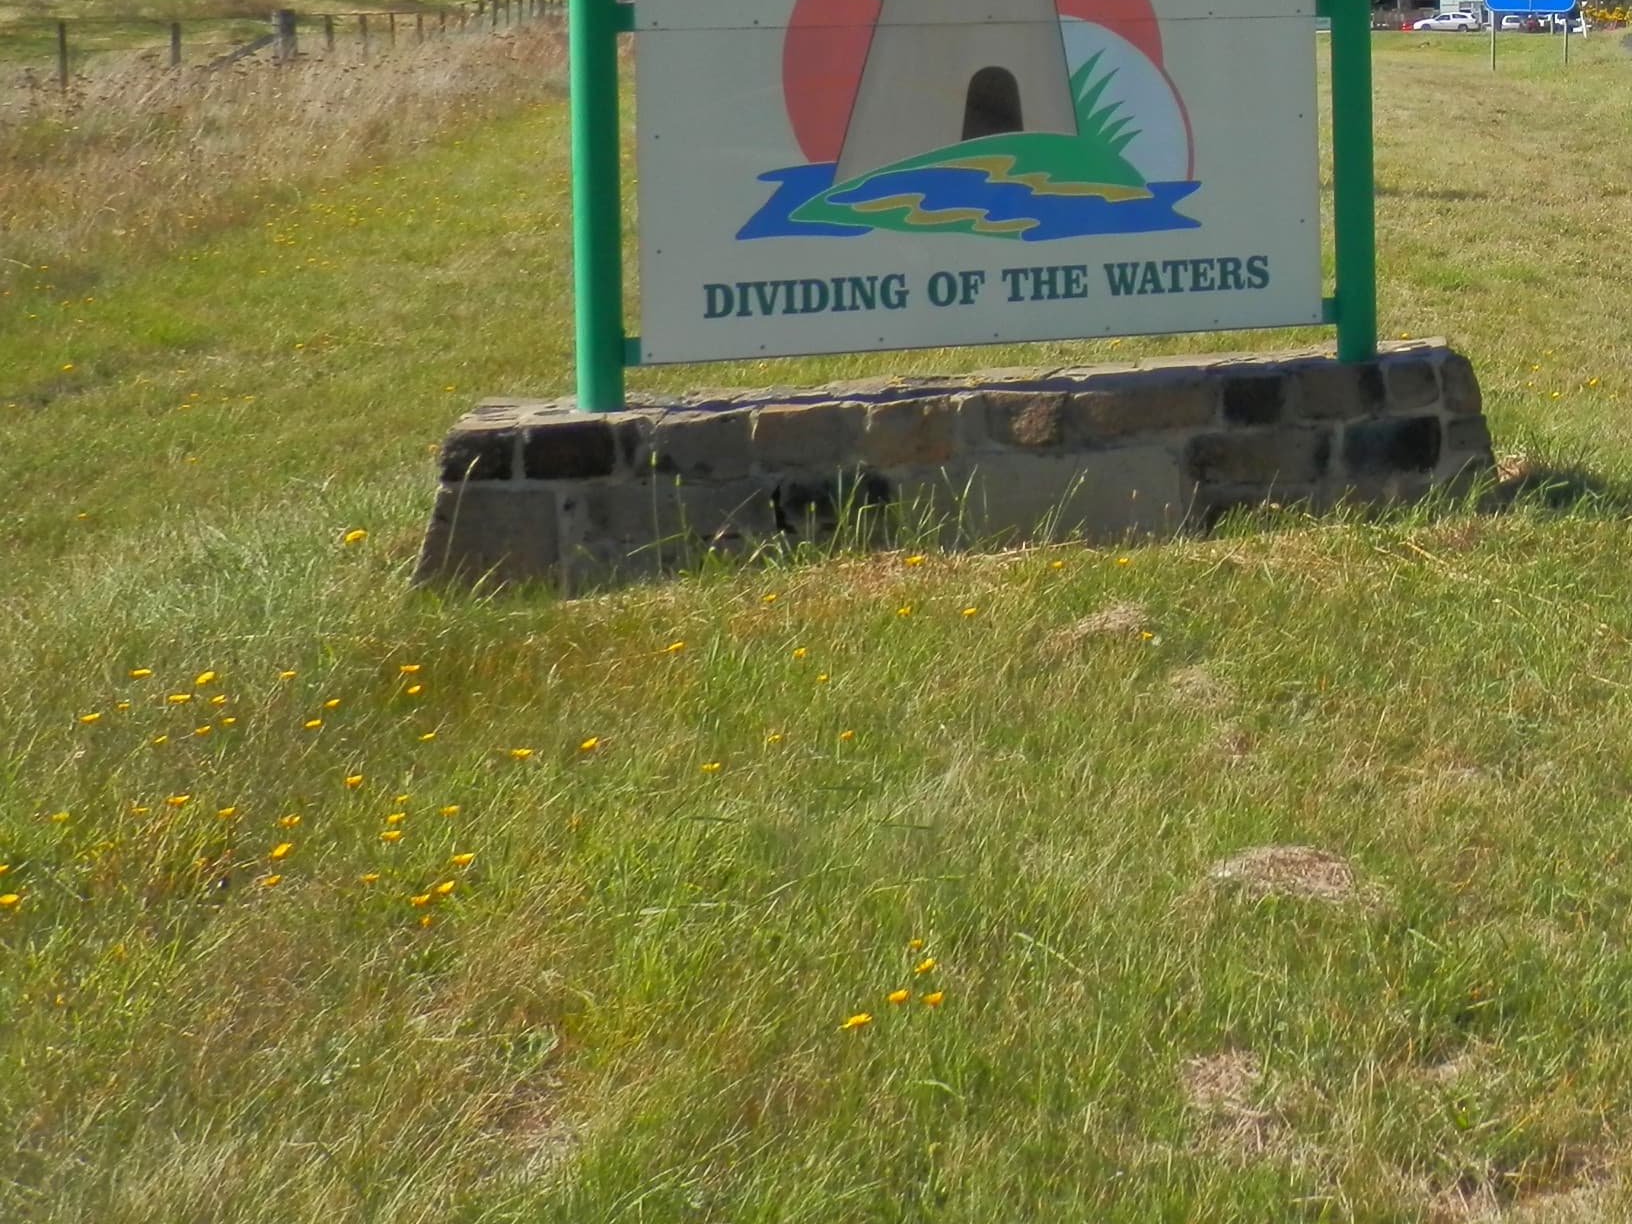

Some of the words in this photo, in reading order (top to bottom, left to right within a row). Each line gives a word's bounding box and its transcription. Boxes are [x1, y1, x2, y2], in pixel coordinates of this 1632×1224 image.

[703, 273, 910, 319] DIVIDING
[927, 270, 985, 307] OF
[1001, 264, 1089, 303] THE
[1104, 255, 1270, 296] WATERS
